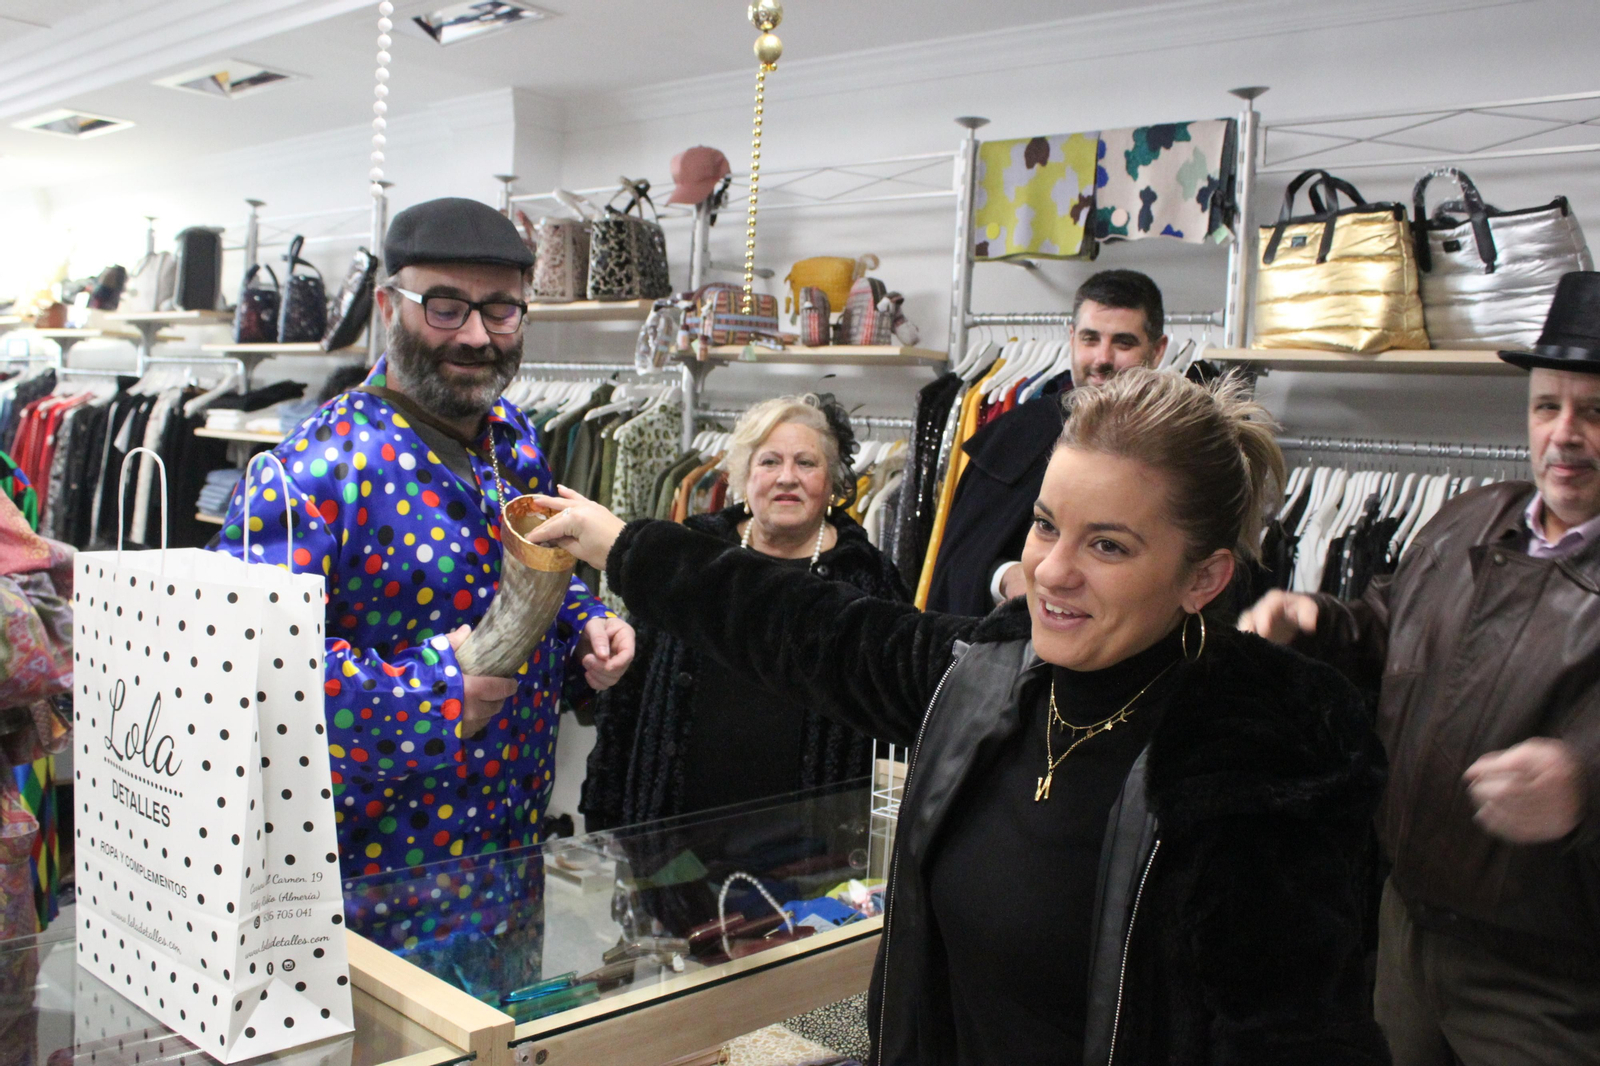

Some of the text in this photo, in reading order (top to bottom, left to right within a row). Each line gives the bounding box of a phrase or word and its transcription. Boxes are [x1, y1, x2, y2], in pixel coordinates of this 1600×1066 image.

[104, 678, 183, 777] Lola
[112, 778, 171, 828] DETALLES
[100, 840, 188, 899] ROPA Y COMPLEMENTOS
[311, 871, 323, 883] 19
[276, 909, 294, 920] 705
[295, 907, 312, 918] 041
